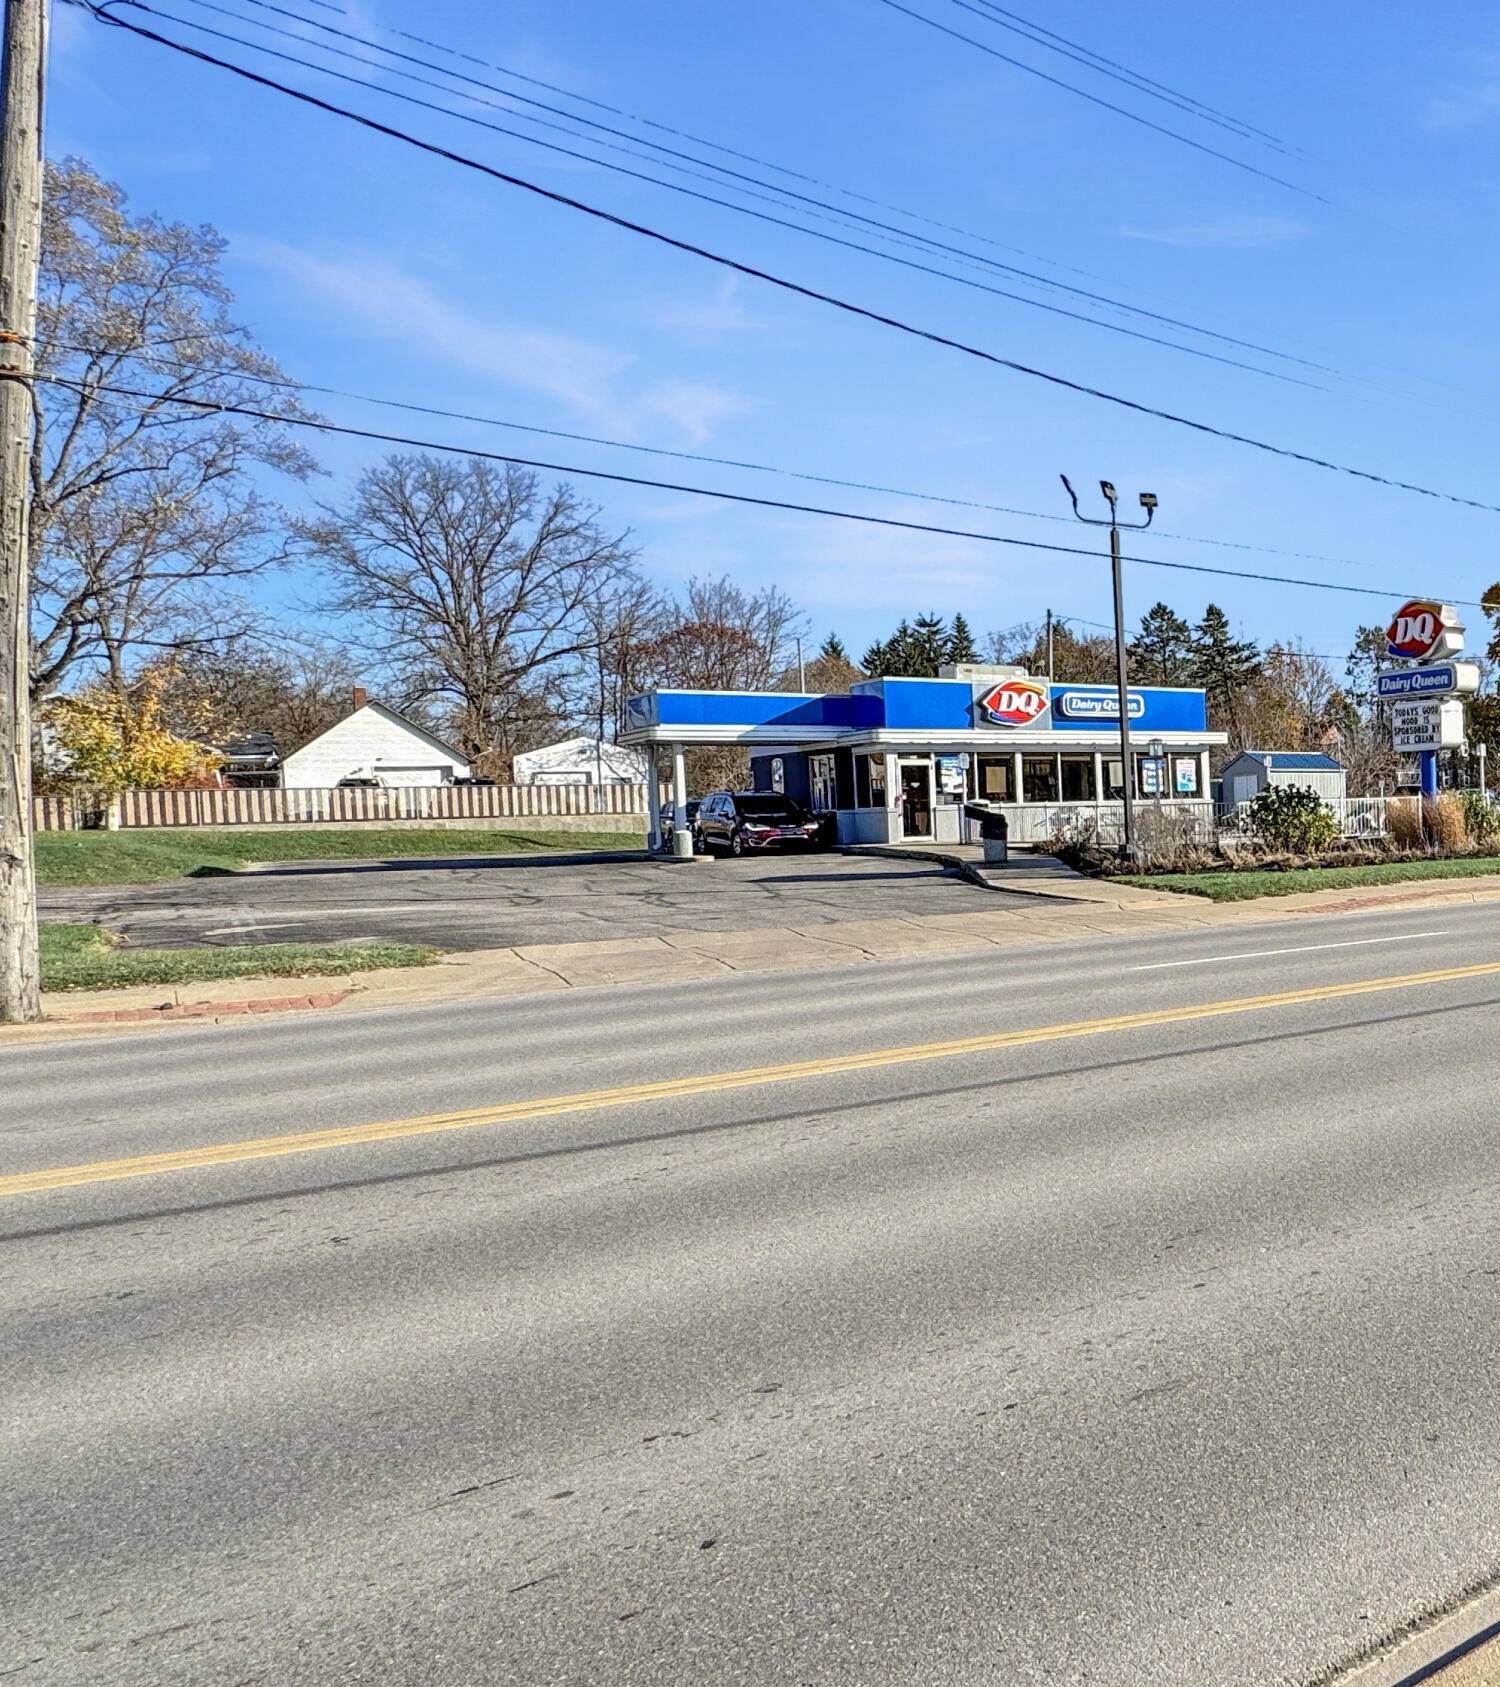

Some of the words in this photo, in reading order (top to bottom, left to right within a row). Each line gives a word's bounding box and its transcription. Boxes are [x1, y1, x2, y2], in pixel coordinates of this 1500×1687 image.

[1395, 613, 1435, 645] DQ
[1380, 678, 1411, 692] Dairy
[1412, 674, 1448, 690] Queen
[999, 691, 1038, 715] DQ
[1071, 699, 1101, 711] Dairy
[1102, 699, 1139, 711] Quen
[1394, 707, 1419, 717] TODAYS
[1421, 705, 1439, 715] GOOD
[1401, 717, 1419, 726] MOOD
[1423, 715, 1430, 724] IS
[1394, 725, 1429, 736] SPONSORED
[1432, 724, 1440, 734] BY
[1400, 736, 1410, 745] ICE
[1413, 734, 1435, 744] CREAM
